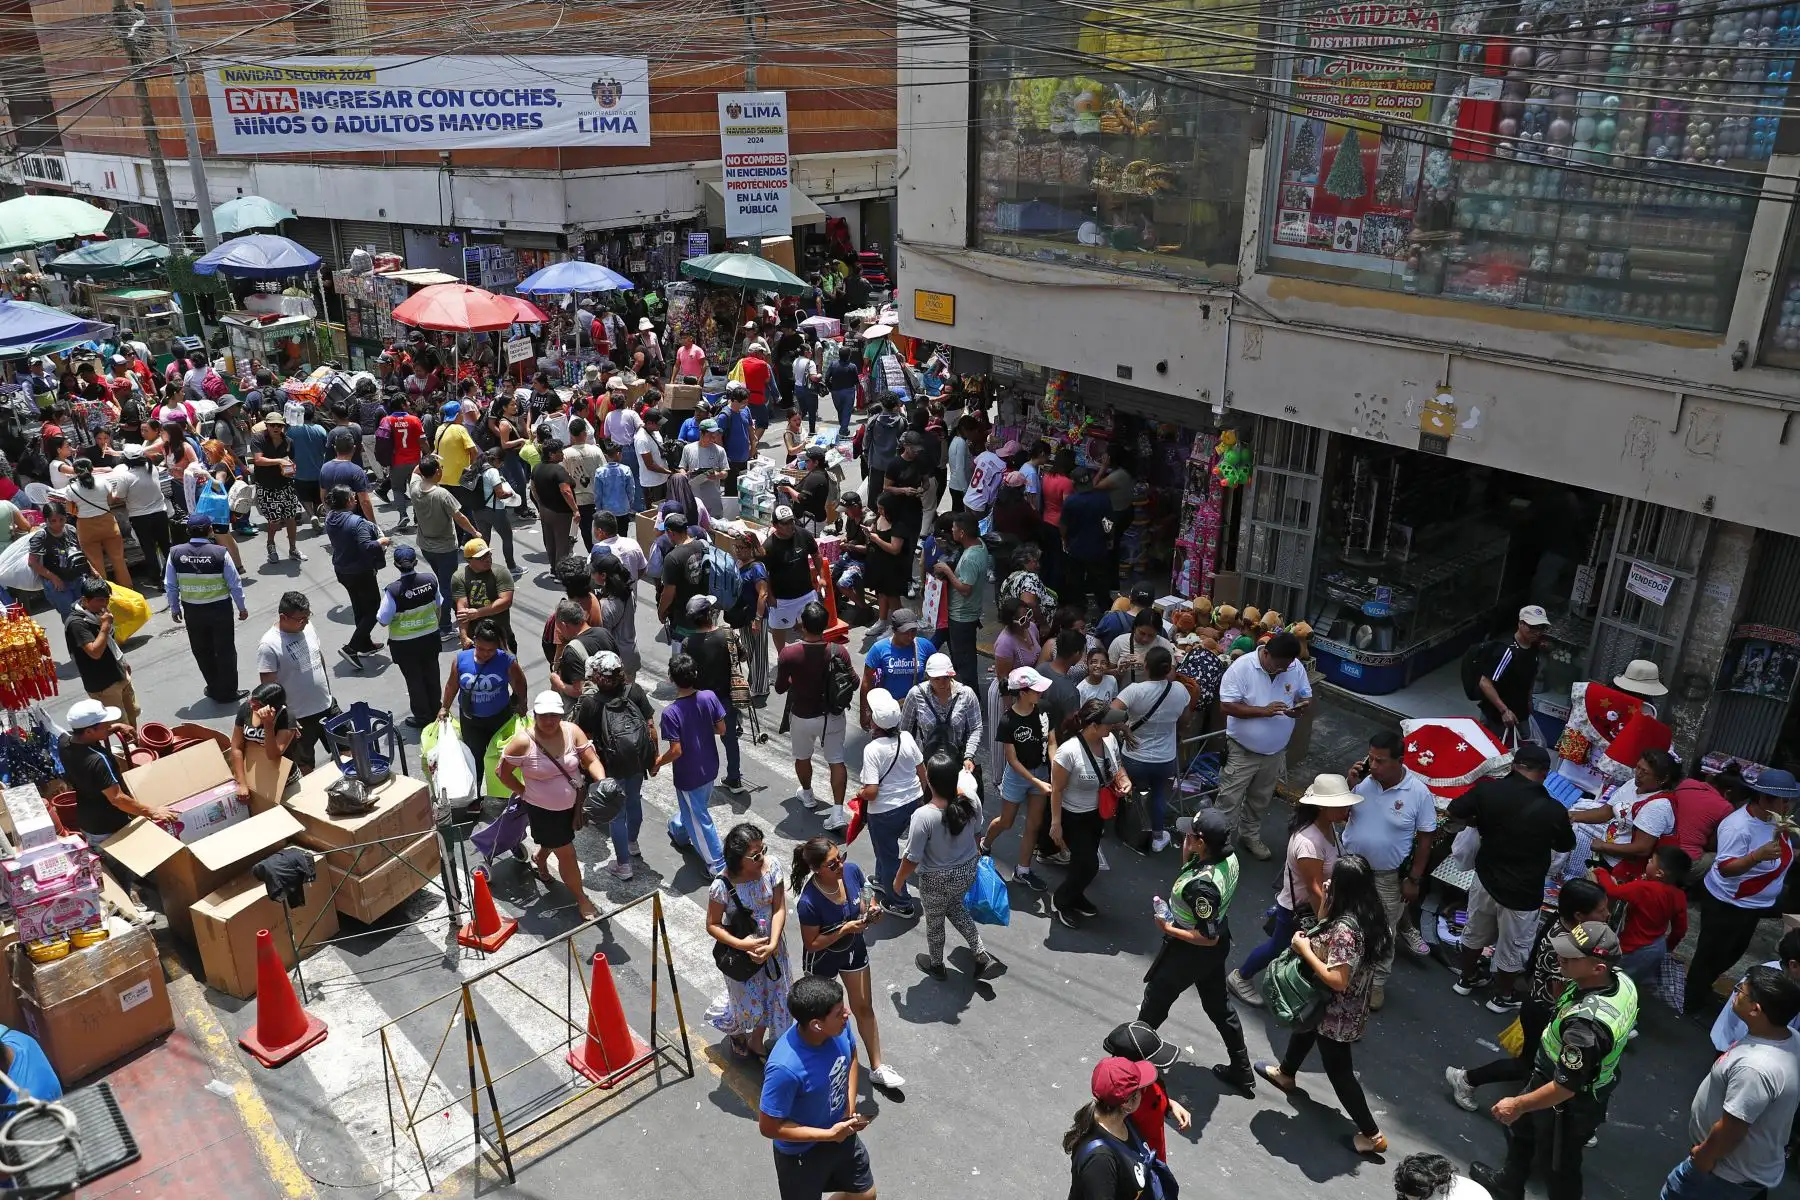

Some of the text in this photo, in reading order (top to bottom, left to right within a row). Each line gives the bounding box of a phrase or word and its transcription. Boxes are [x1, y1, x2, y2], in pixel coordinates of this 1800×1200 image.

[1310, 36, 1428, 48] DISTRIBUIDOR
[225, 69, 371, 81] NAVIDAD SEGURA 2024
[1396, 80, 1433, 90] Menor
[228, 91, 297, 111] EVITA
[299, 88, 563, 110] INGRESAR CON COCHES,
[1297, 93, 1422, 107] INTERIOR # 202 2do PISO
[743, 106, 781, 118] LIMA
[234, 112, 543, 135] NIÑOS O ADULTOS MAYORES
[578, 116, 639, 133] LIMA
[726, 126, 783, 135] NAVIDAD SEGURA
[726, 154, 786, 165] NO COMPRES
[726, 167, 788, 177] NI ENCIENDAS
[727, 178, 788, 190] PIROTÉCNICOS
[737, 190, 779, 202] EN LA VÍA
[739, 204, 778, 214] PÚBLICA
[1284, 405, 1297, 415] 696
[397, 428, 408, 448] 7
[1631, 571, 1669, 594] VENDEDOR
[412, 585, 433, 596] LIMA
[1367, 606, 1386, 616] VISA
[1343, 663, 1360, 675] VISA
